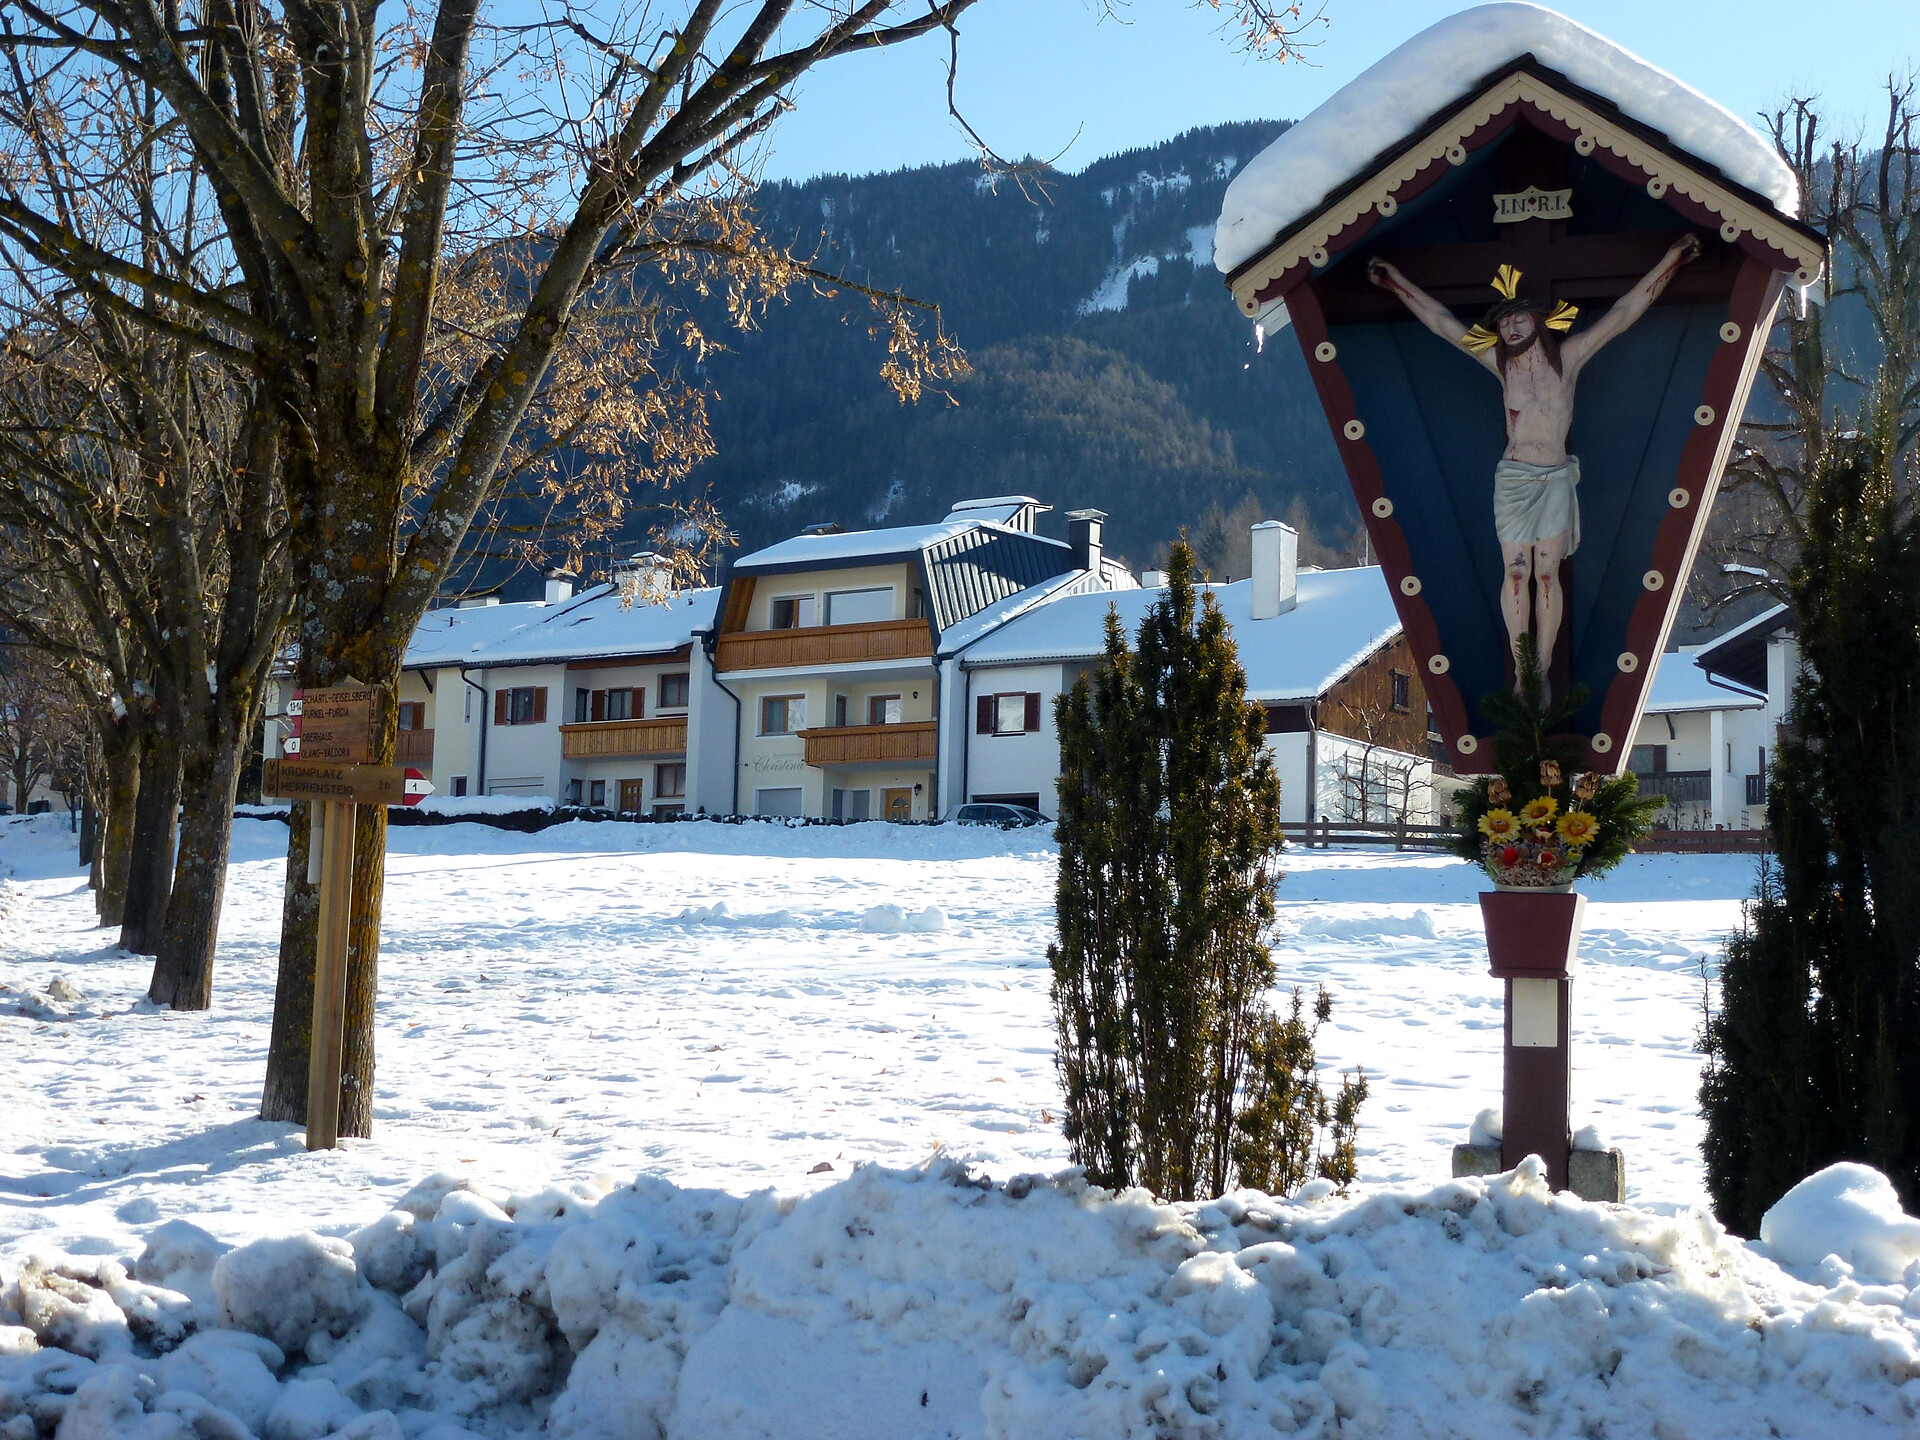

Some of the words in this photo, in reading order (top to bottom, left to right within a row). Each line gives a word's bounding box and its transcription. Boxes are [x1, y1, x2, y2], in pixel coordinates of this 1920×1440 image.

[753, 755, 806, 774] Christina
[281, 780, 354, 797] HERRENSTEIG
[412, 782, 418, 792] 1
